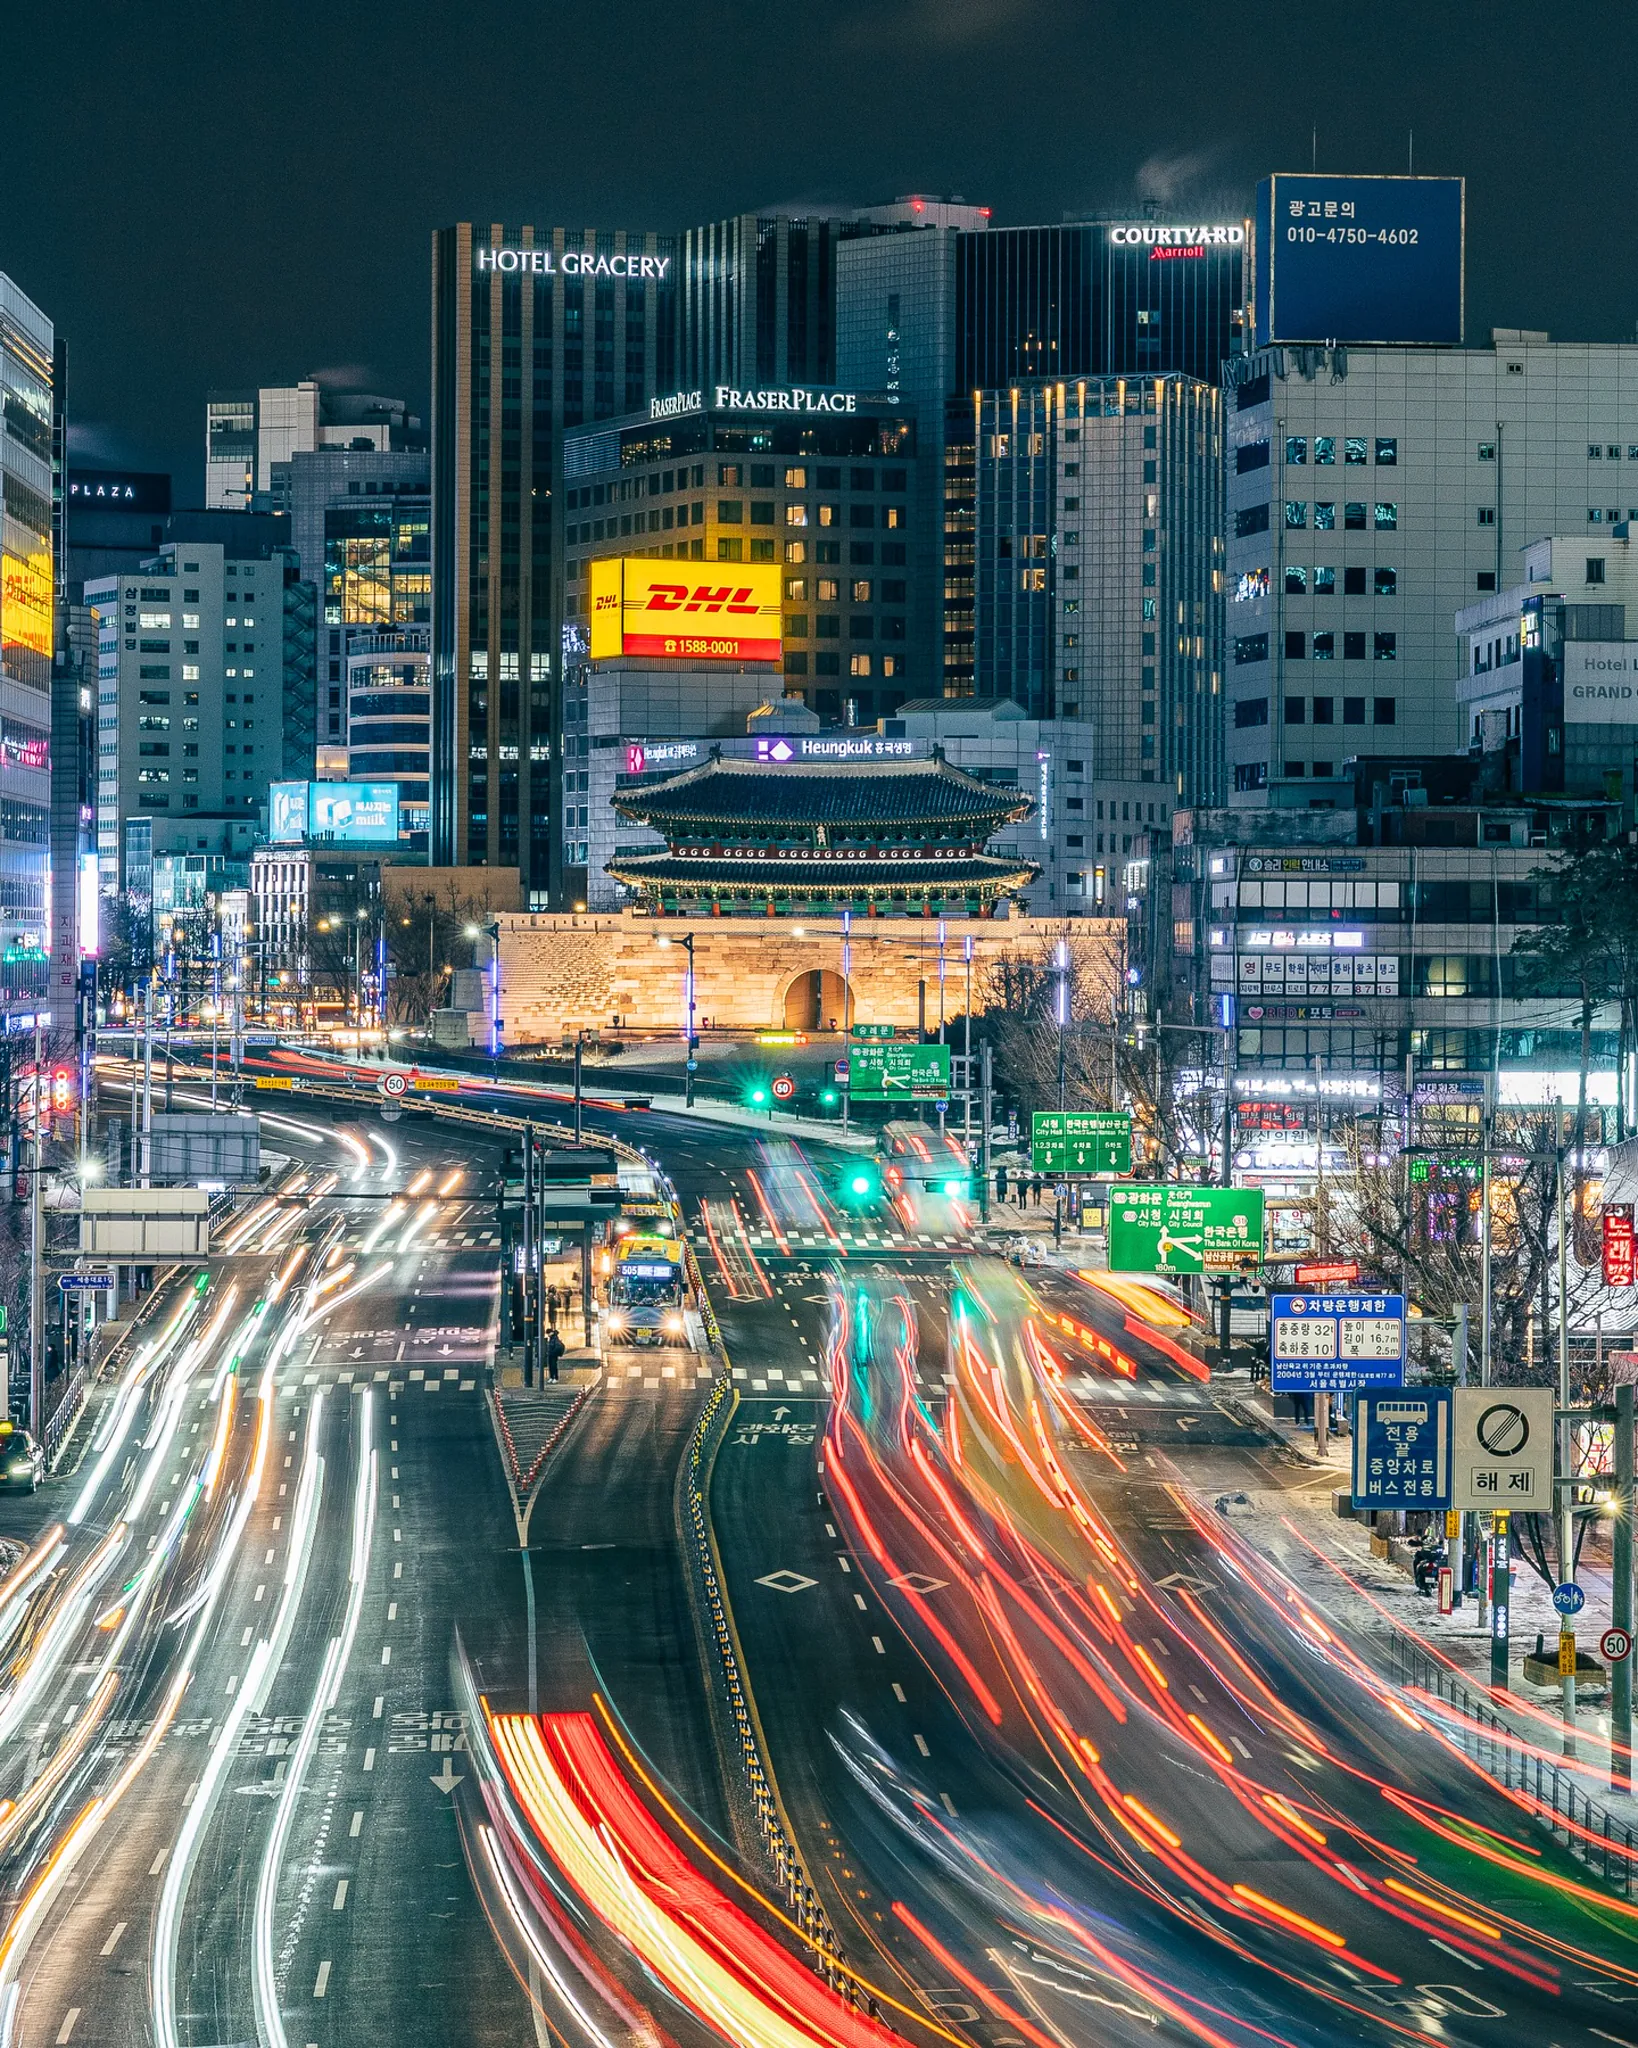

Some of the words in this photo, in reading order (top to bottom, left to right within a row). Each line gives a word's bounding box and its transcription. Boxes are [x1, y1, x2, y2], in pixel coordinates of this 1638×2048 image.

[1288, 200, 1355, 219] 광고문의
[1110, 225, 1243, 245] COURTYARD
[1287, 226, 1419, 245] 010-4750-4602
[1150, 246, 1205, 260] Marriott
[478, 249, 556, 275] HOTEL
[562, 253, 670, 278] GRACERY
[71, 484, 133, 498] PLAZA
[595, 594, 618, 611] DHL
[644, 583, 760, 615] DHL
[125, 587, 138, 651] 삼정빌딩
[679, 639, 739, 655] 1588-0001
[1584, 658, 1627, 671] Hotel
[1572, 685, 1633, 699] GRAND
[801, 740, 872, 758] Heungkuk
[875, 741, 912, 754] 흥국생명
[1264, 859, 1281, 871] 승리
[1283, 859, 1300, 871] 인력
[1302, 859, 1329, 872] 안내소
[1244, 962, 1256, 975] 영
[1264, 962, 1282, 974] 무도
[1288, 963, 1305, 975] 학원
[1357, 963, 1374, 975] 왈츠
[1265, 984, 1283, 993] 브루스
[1309, 1007, 1332, 1019] 포토
[858, 1026, 889, 1036] 숭례문
[911, 1069, 940, 1077] 한국은행
[388, 1078, 403, 1091] 50
[776, 1083, 789, 1094] 50
[1041, 1119, 1059, 1129] 시청
[1128, 1192, 1163, 1205] 광화문
[1138, 1208, 1162, 1221] 시청
[1169, 1209, 1204, 1221] 시의회
[1137, 1220, 1149, 1228] City
[1168, 1220, 1180, 1228] City
[1204, 1226, 1248, 1239] 한국은행
[1203, 1239, 1216, 1247] The
[1216, 1239, 1232, 1247] Bank
[1241, 1239, 1260, 1248] Korea
[1205, 1251, 1234, 1263] 남산공원
[621, 1266, 638, 1276] 505
[1154, 1263, 1177, 1272] 180m
[1308, 1299, 1387, 1313] 차량운행제한
[1279, 1322, 1310, 1336] 총중량
[1343, 1321, 1365, 1331] 높이
[1375, 1321, 1399, 1331] 4.0m
[1343, 1333, 1364, 1344] 길이
[1370, 1334, 1399, 1343] 16.7m
[1278, 1341, 1310, 1355] 축하중
[1349, 1345, 1360, 1356] 폭
[1375, 1346, 1399, 1355] 2.5m
[1276, 1371, 1302, 1379] 2004년
[1304, 1371, 1316, 1379] 3월
[1309, 1379, 1367, 1388] 서울특별시장
[1385, 1426, 1419, 1442] 전용
[1394, 1443, 1410, 1458] 끝
[1369, 1458, 1435, 1476] 중앙차로
[1369, 1479, 1434, 1497] 버스전용
[1606, 1637, 1626, 1654] 50
